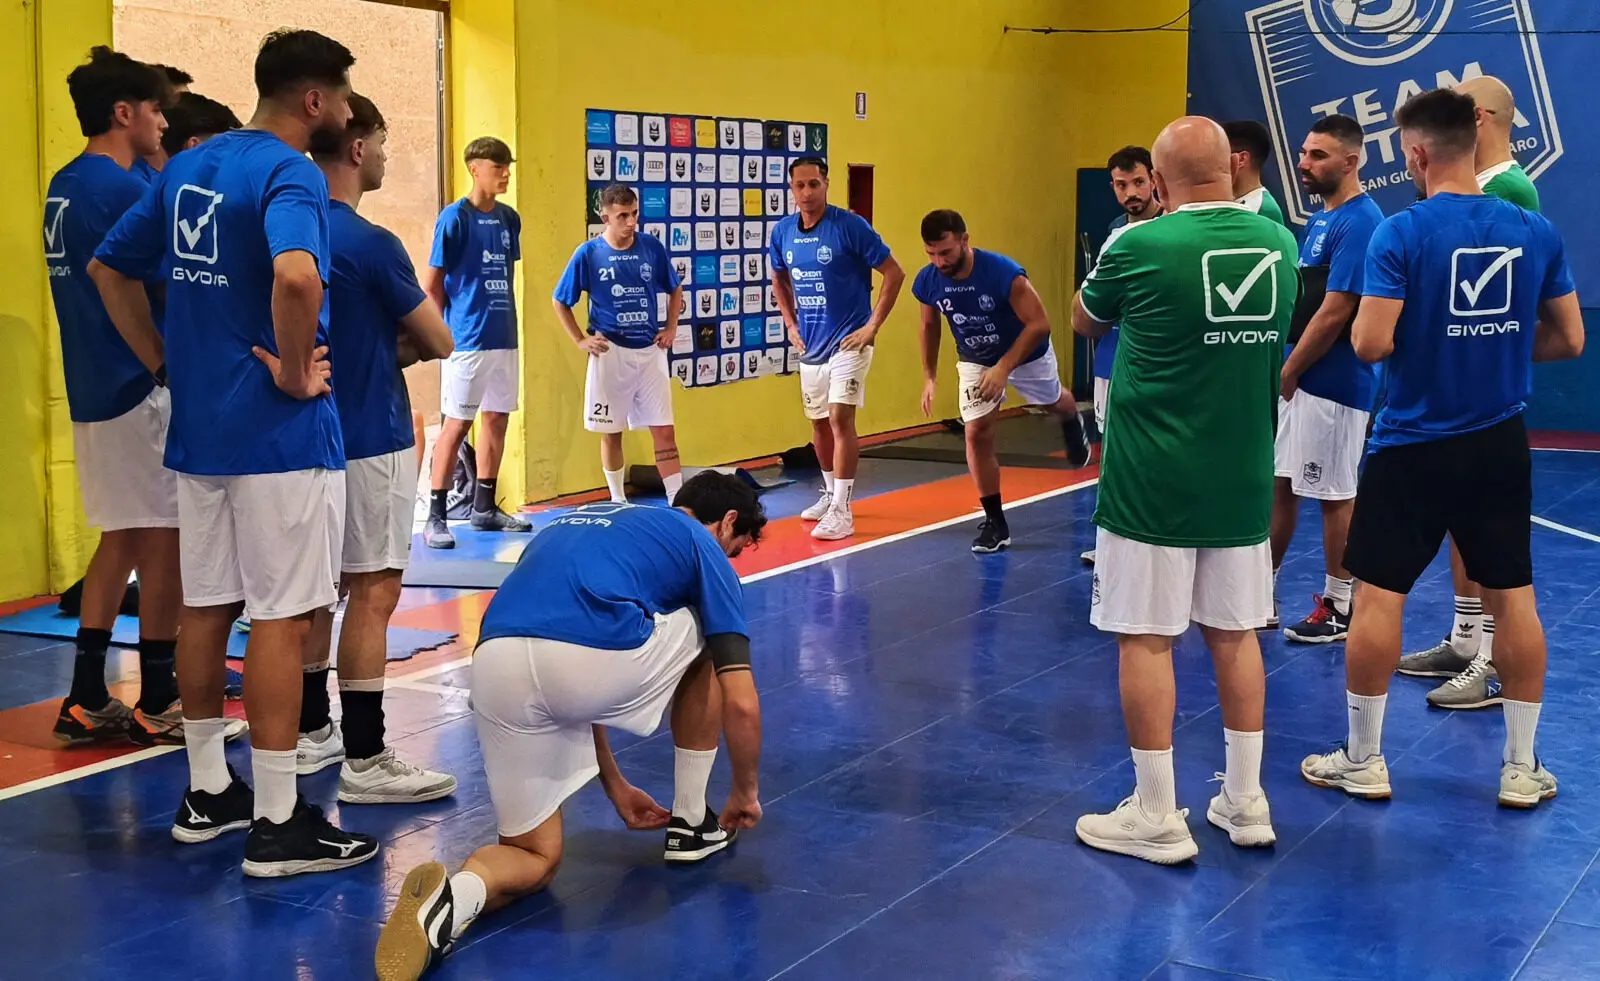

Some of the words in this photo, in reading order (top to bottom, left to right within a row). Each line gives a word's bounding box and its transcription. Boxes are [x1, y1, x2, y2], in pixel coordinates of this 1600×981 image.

[1360, 175, 1388, 193] SAN
[786, 250, 793, 265] 9
[598, 266, 616, 282] 21
[936, 298, 954, 313] 12
[1446, 320, 1520, 337] GIVOVA
[1203, 330, 1280, 345] GIVOVA
[593, 402, 610, 417] 21
